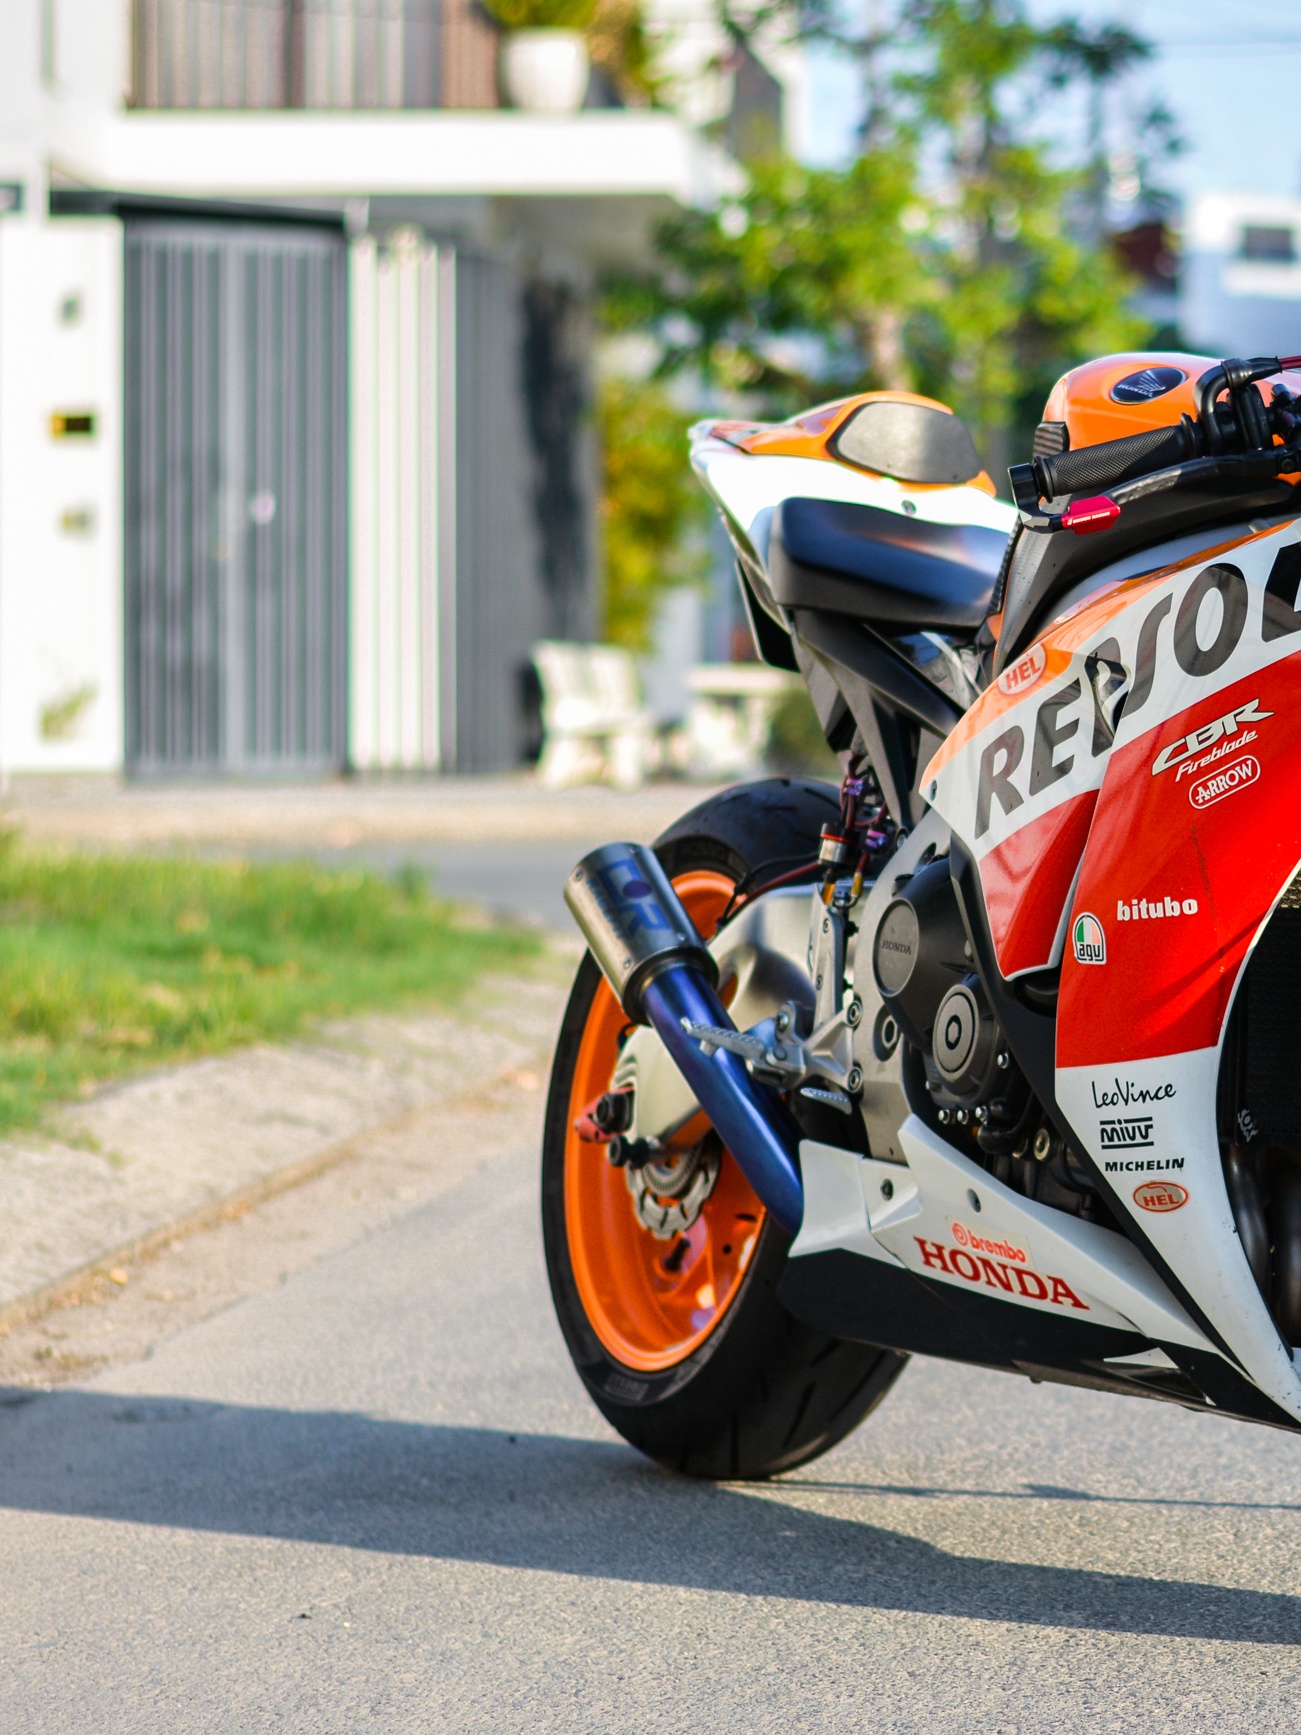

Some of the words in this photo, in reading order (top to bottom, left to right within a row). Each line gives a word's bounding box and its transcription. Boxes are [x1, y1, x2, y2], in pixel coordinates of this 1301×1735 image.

[1005, 656, 1041, 690] HEL
[1151, 698, 1275, 777] CBR
[1175, 730, 1258, 782] Fireblade
[1195, 759, 1253, 804] ARROW
[1117, 896, 1198, 921] bitubo
[882, 940, 912, 955] HONDA
[1091, 1077, 1177, 1109] LeoVince
[1105, 1157, 1185, 1172] MICHELIN
[1143, 1193, 1180, 1207] HEL
[968, 1229, 1026, 1263] brembo
[913, 1235, 1090, 1310] HONDA
